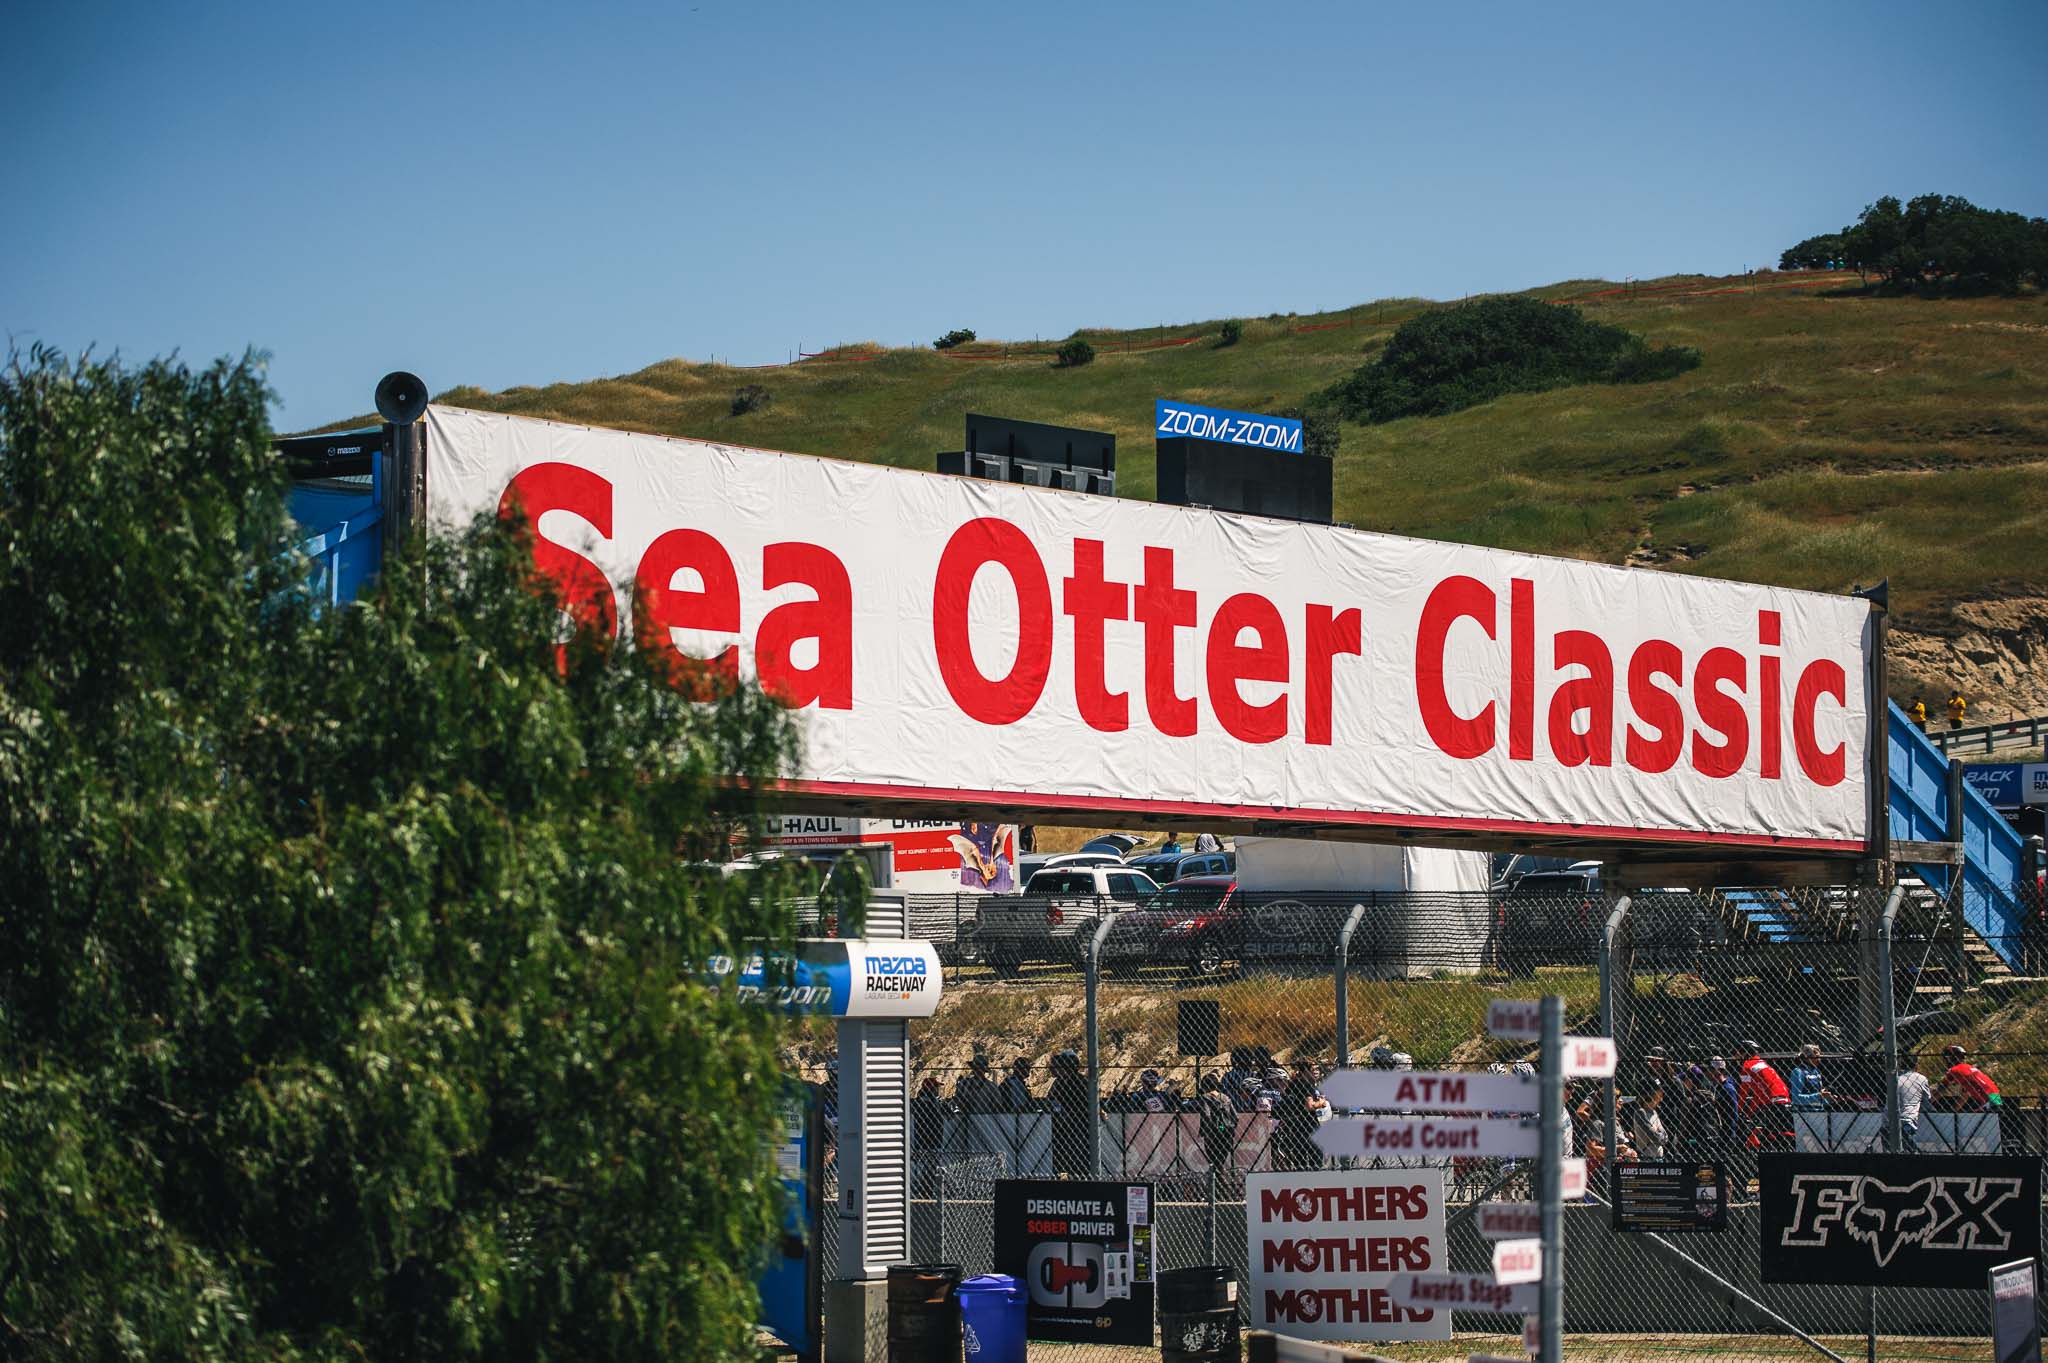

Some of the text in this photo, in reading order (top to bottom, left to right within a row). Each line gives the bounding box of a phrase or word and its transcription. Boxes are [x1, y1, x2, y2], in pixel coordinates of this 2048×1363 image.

[1159, 408, 1301, 451] ZOOM-ZOOM
[497, 461, 1846, 787] Sea Otter Classic
[1966, 770, 2015, 783] BACK
[767, 815, 842, 834] U-HAUL
[865, 956, 927, 975] mazda
[866, 976, 927, 992] RACEWAY
[1395, 1077, 1467, 1103] ATM
[1363, 1124, 1479, 1150] Food Court
[1620, 1167, 1639, 1176] LADIES
[1027, 1199, 1101, 1216] DESIGNATE
[1104, 1201, 1115, 1216] A
[1261, 1184, 1429, 1223] MOTHERS
[1027, 1220, 1115, 1236] SOBER DRIVER
[1263, 1236, 1431, 1274] MOTHERS
[1409, 1276, 1513, 1311] Awards Stage
